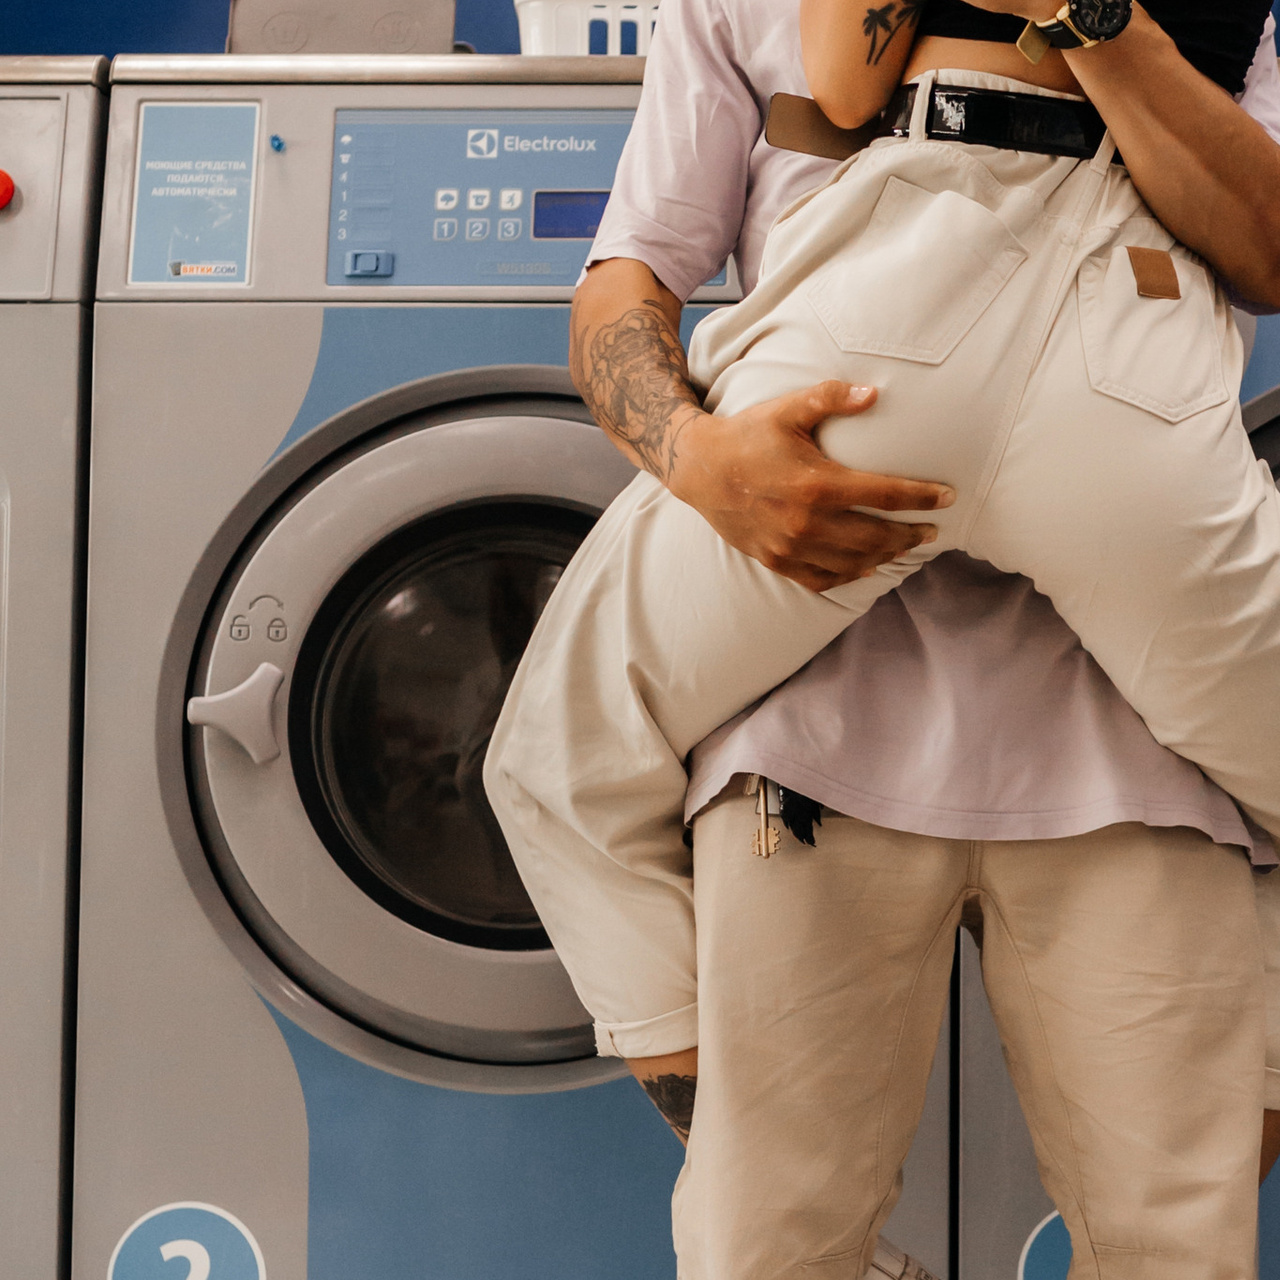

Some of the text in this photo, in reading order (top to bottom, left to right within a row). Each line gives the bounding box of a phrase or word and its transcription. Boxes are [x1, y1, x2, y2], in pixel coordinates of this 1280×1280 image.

[503, 135, 597, 152] Electrolux
[145, 160, 247, 170] МОЮЩИЕ СРЕДСТВА
[166, 173, 224, 183] ПОДАЮТСЯ
[151, 186, 238, 196] АВТОМАТИЧЕСКИ
[338, 209, 348, 221] 2
[337, 228, 347, 240] 3
[440, 222, 515, 238] 1 2 3
